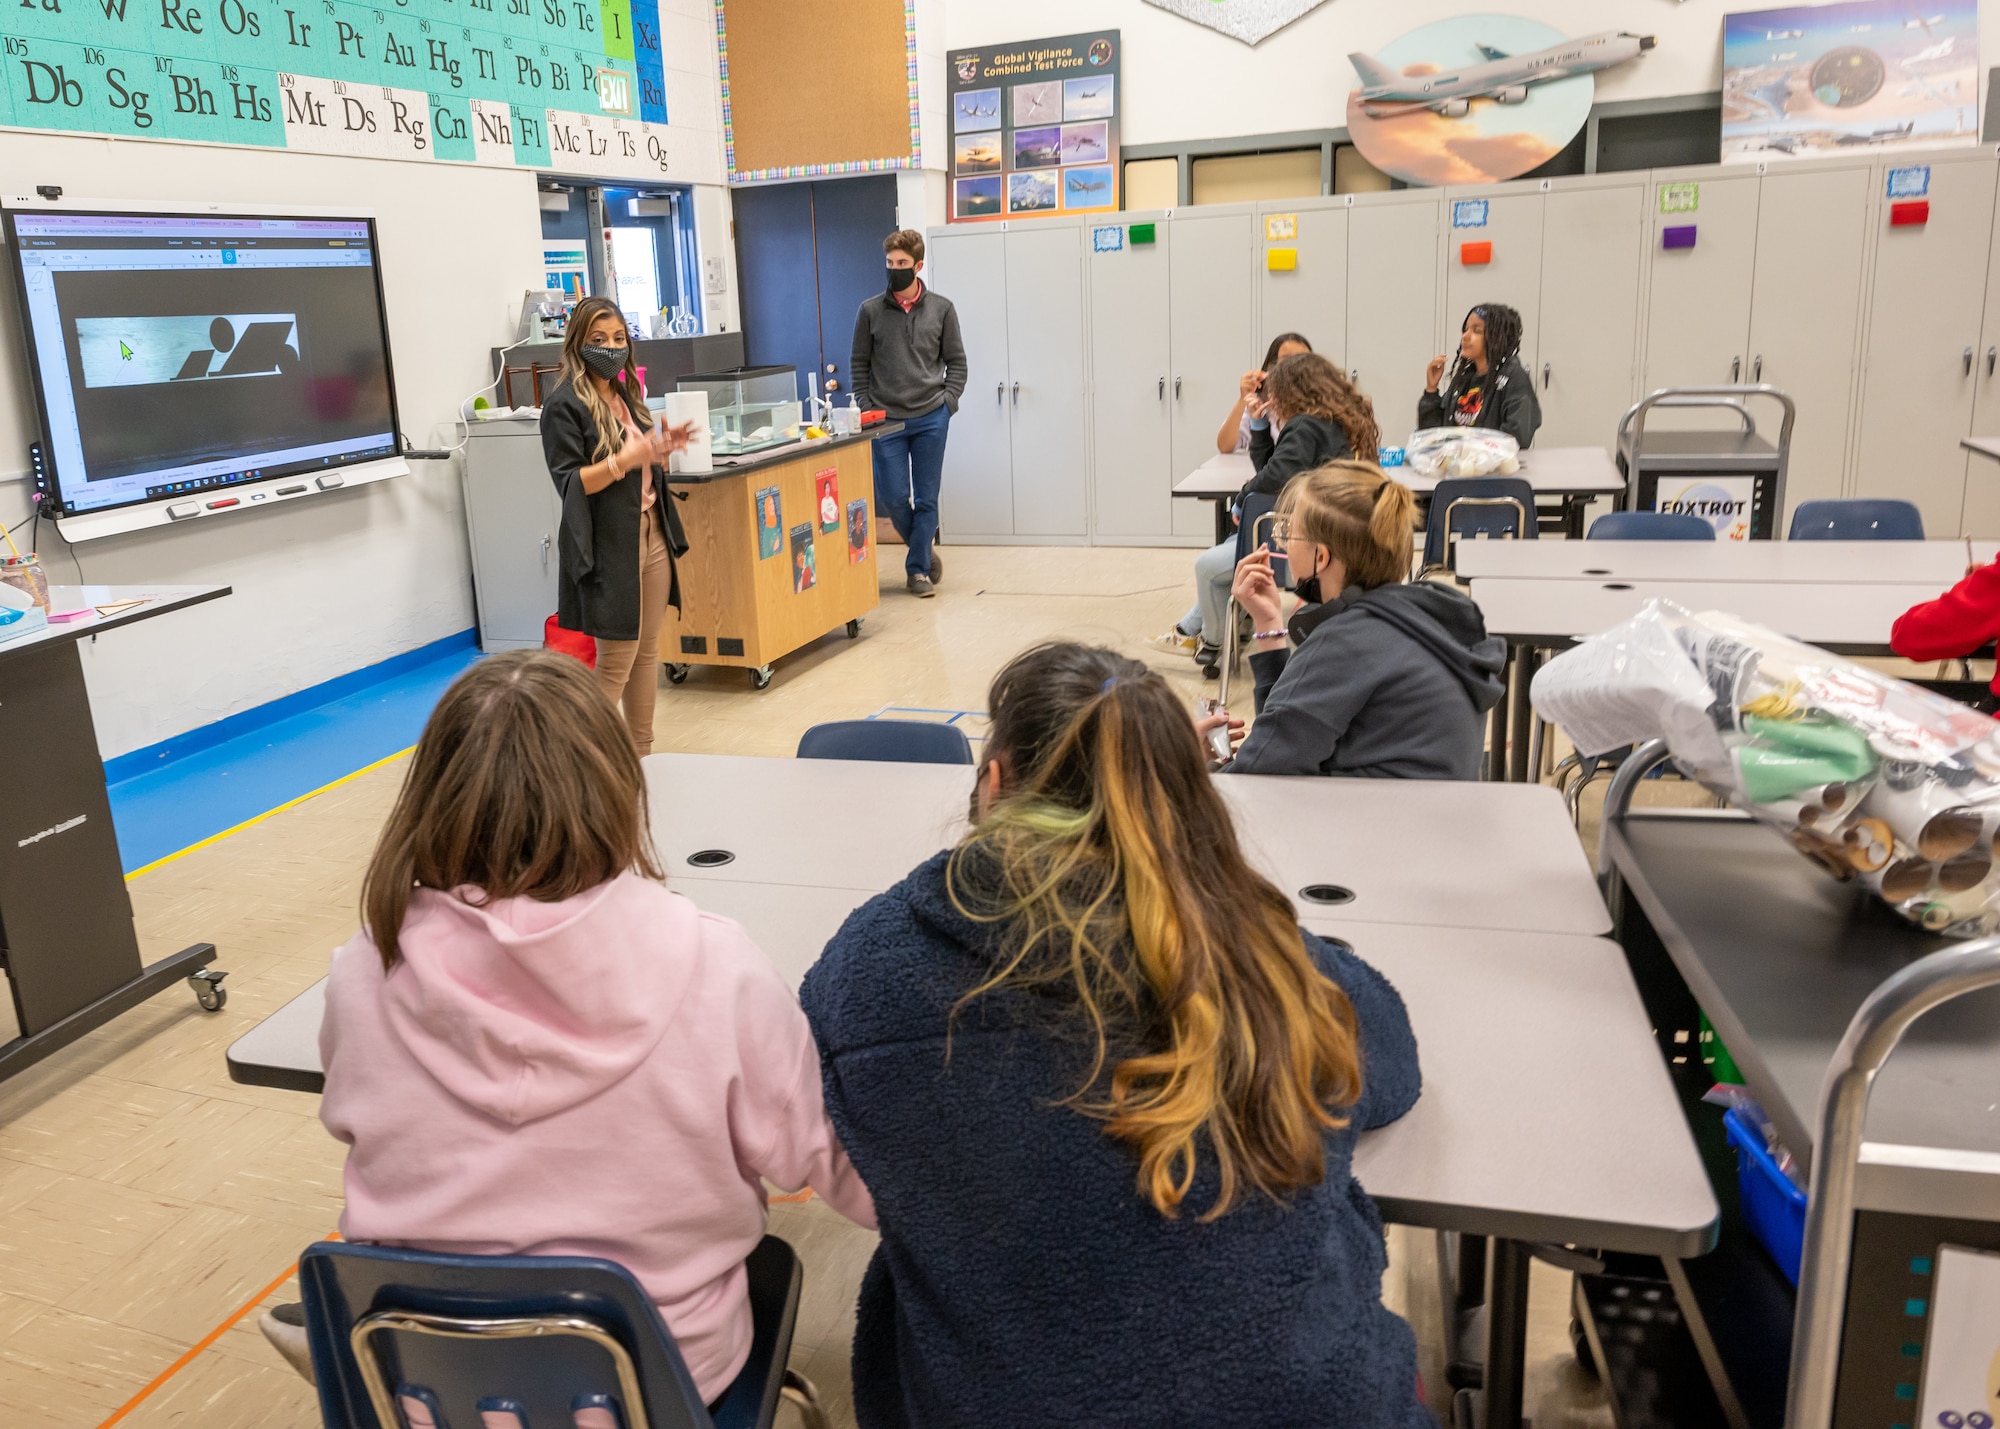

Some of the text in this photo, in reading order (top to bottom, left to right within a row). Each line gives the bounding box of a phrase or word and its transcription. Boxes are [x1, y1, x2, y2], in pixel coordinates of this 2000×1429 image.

[161, 0, 203, 34] Re
[220, 0, 260, 37] Os
[323, 0, 335, 16] 78
[373, 10, 385, 24] 79
[544, 0, 566, 27] Sb
[573, 3, 594, 32] Te
[284, 9, 311, 48] Ir
[420, 20, 430, 33] 80
[463, 28, 471, 42] 81
[613, 13, 622, 39] I
[637, 22, 658, 51] Xe
[4, 37, 28, 56] 105
[335, 21, 366, 59] Pt
[384, 32, 416, 67] Au
[503, 37, 513, 50] 82
[540, 45, 549, 57] 83
[83, 47, 105, 66] 106
[154, 56, 173, 74] 107
[426, 39, 463, 88] Hg
[472, 47, 497, 80] Tl
[574, 52, 583, 63] 84
[606, 58, 614, 69] 85
[984, 56, 1084, 78] Combined Test Force
[994, 51, 1025, 65] Global
[1028, 47, 1073, 61] Vigilance
[1543, 57, 1555, 66] AIR
[1557, 51, 1583, 62] FORCE
[20, 60, 83, 107] Db
[220, 65, 239, 81] 108
[279, 72, 295, 88] 109
[515, 55, 542, 88] Pb
[550, 62, 571, 91] Bi
[105, 68, 152, 128] Sg
[169, 75, 218, 116] Bh
[333, 80, 347, 95] 110
[382, 87, 393, 100] 111
[428, 94, 440, 107] 112
[600, 73, 628, 110] EXIT
[642, 79, 663, 106] Rn
[229, 82, 272, 122] Hs
[286, 89, 327, 127] Mt
[342, 97, 377, 133] Ds
[470, 100, 482, 112] 113
[510, 105, 520, 118] 114
[547, 110, 556, 121] 115
[390, 101, 426, 150] Rg
[434, 107, 467, 139] Cn
[478, 112, 512, 145] Nh
[520, 118, 542, 148] Fl
[553, 124, 581, 153] Mc
[587, 129, 607, 156] Lv
[618, 131, 636, 157] Ts
[647, 135, 668, 172] Og
[1660, 500, 1747, 517] FOXTROT
